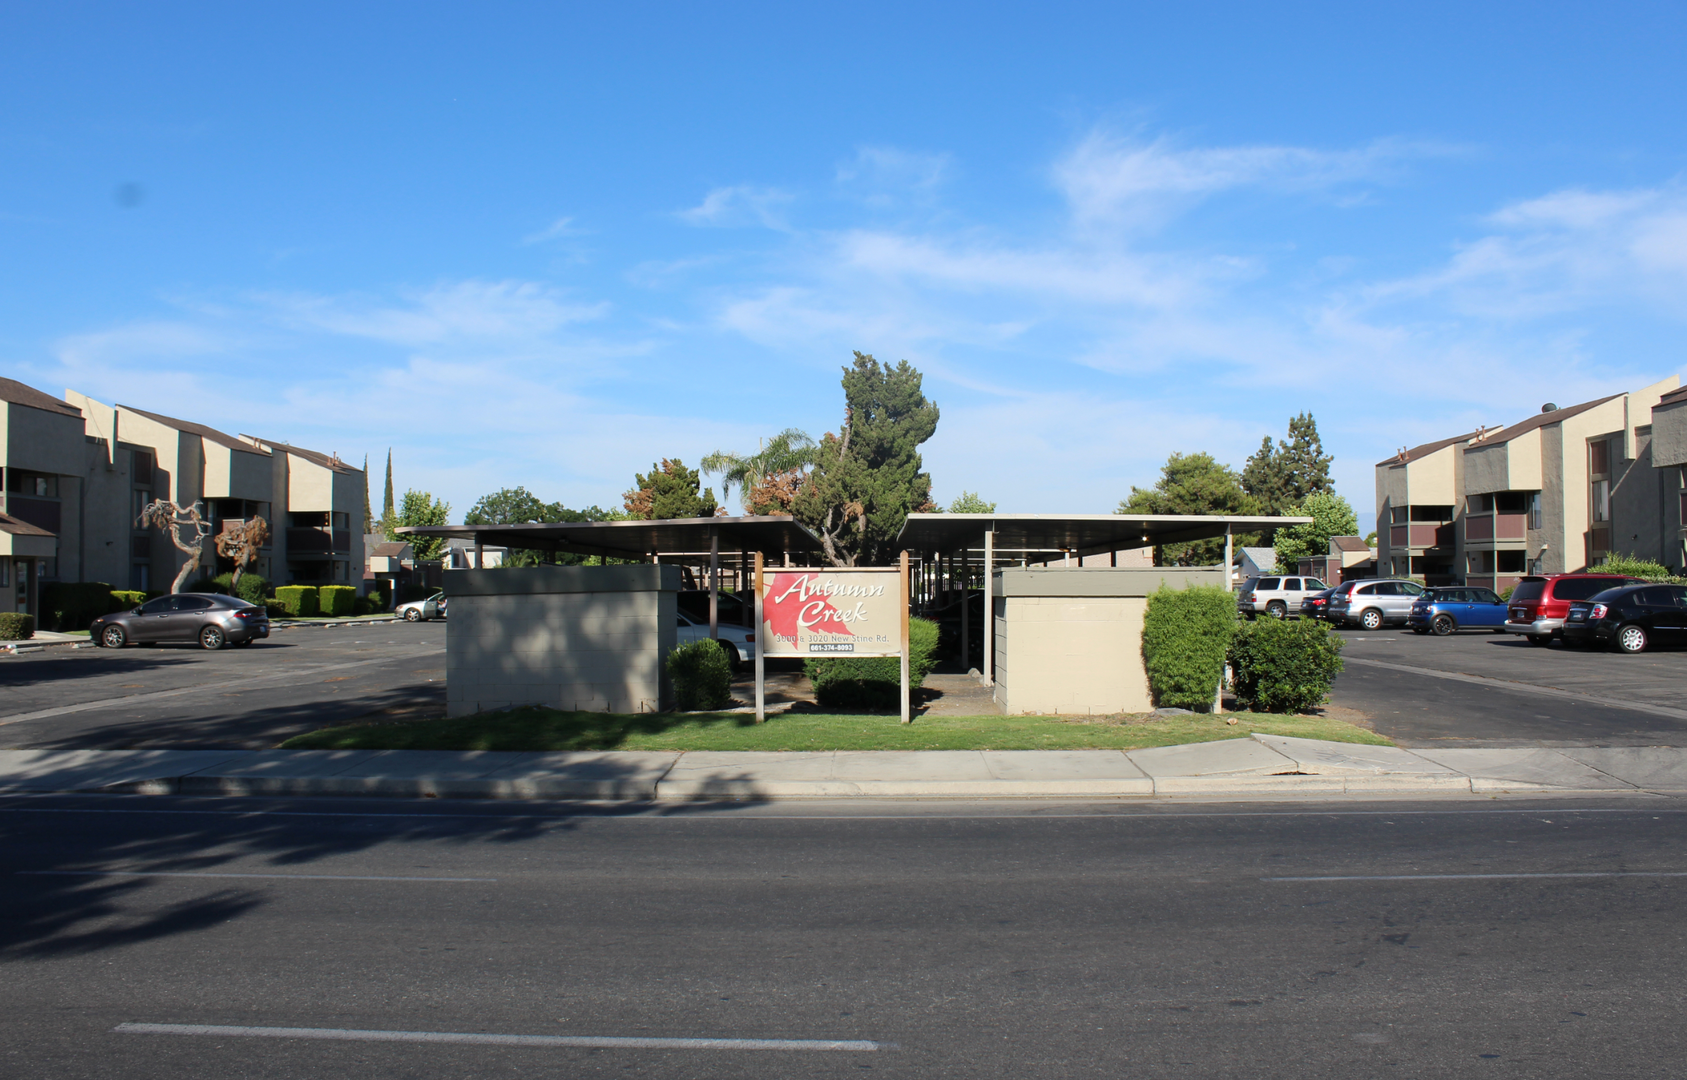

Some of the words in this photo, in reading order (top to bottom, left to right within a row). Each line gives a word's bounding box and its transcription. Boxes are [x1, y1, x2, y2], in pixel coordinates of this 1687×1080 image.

[775, 574, 884, 604] Autumn
[798, 601, 868, 627] Creek
[776, 635, 796, 643] 3000
[808, 635, 829, 643] 3020
[851, 634, 873, 642] Stine
[876, 634, 889, 642] Rd.
